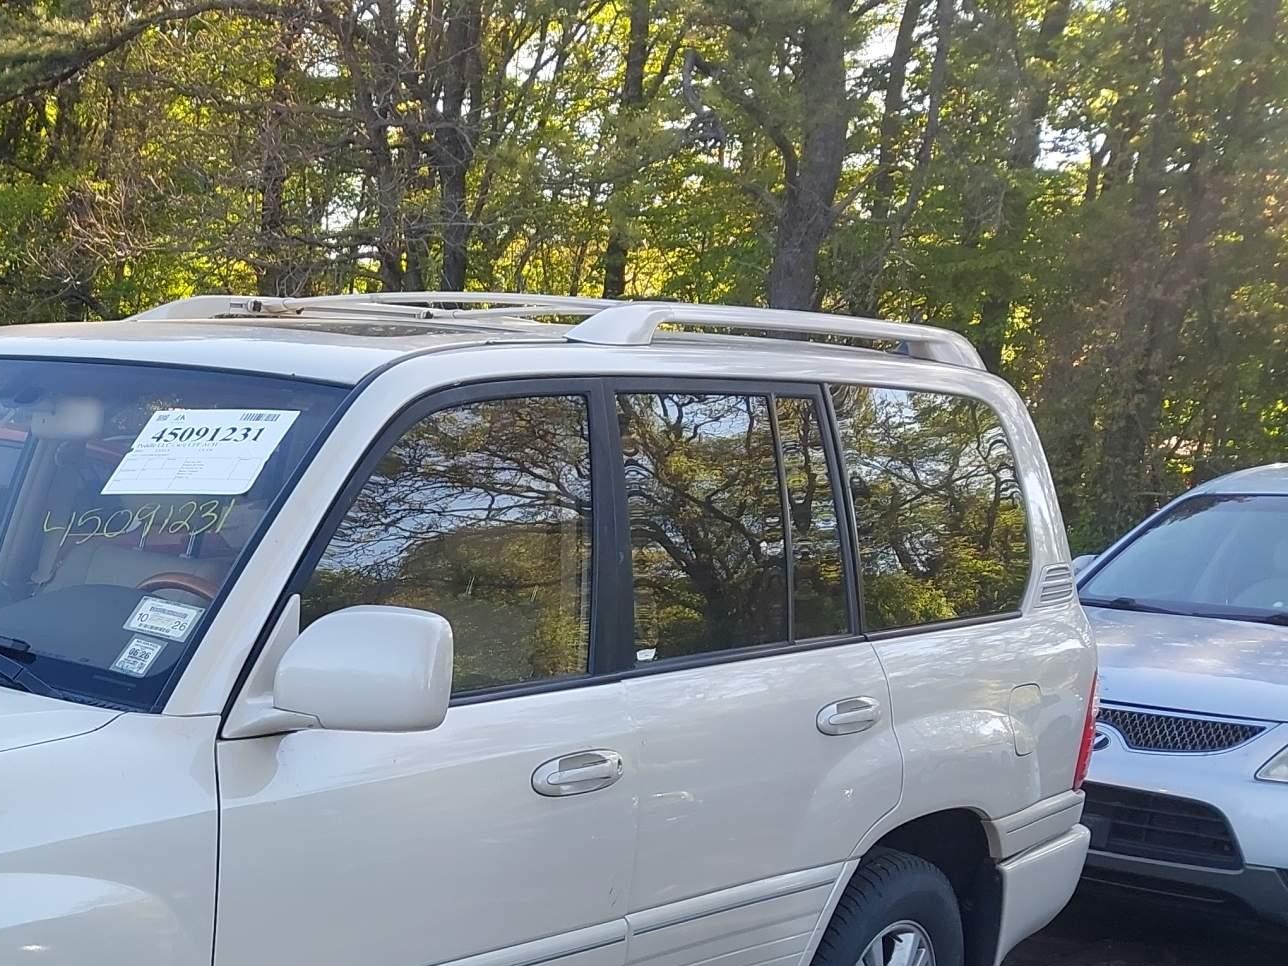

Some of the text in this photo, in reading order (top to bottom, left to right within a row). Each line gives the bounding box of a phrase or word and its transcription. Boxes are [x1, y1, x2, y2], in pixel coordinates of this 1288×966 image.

[151, 426, 265, 443] 45091231
[43, 499, 236, 546] 45091231
[137, 612, 149, 623] 10
[171, 620, 188, 632] 26
